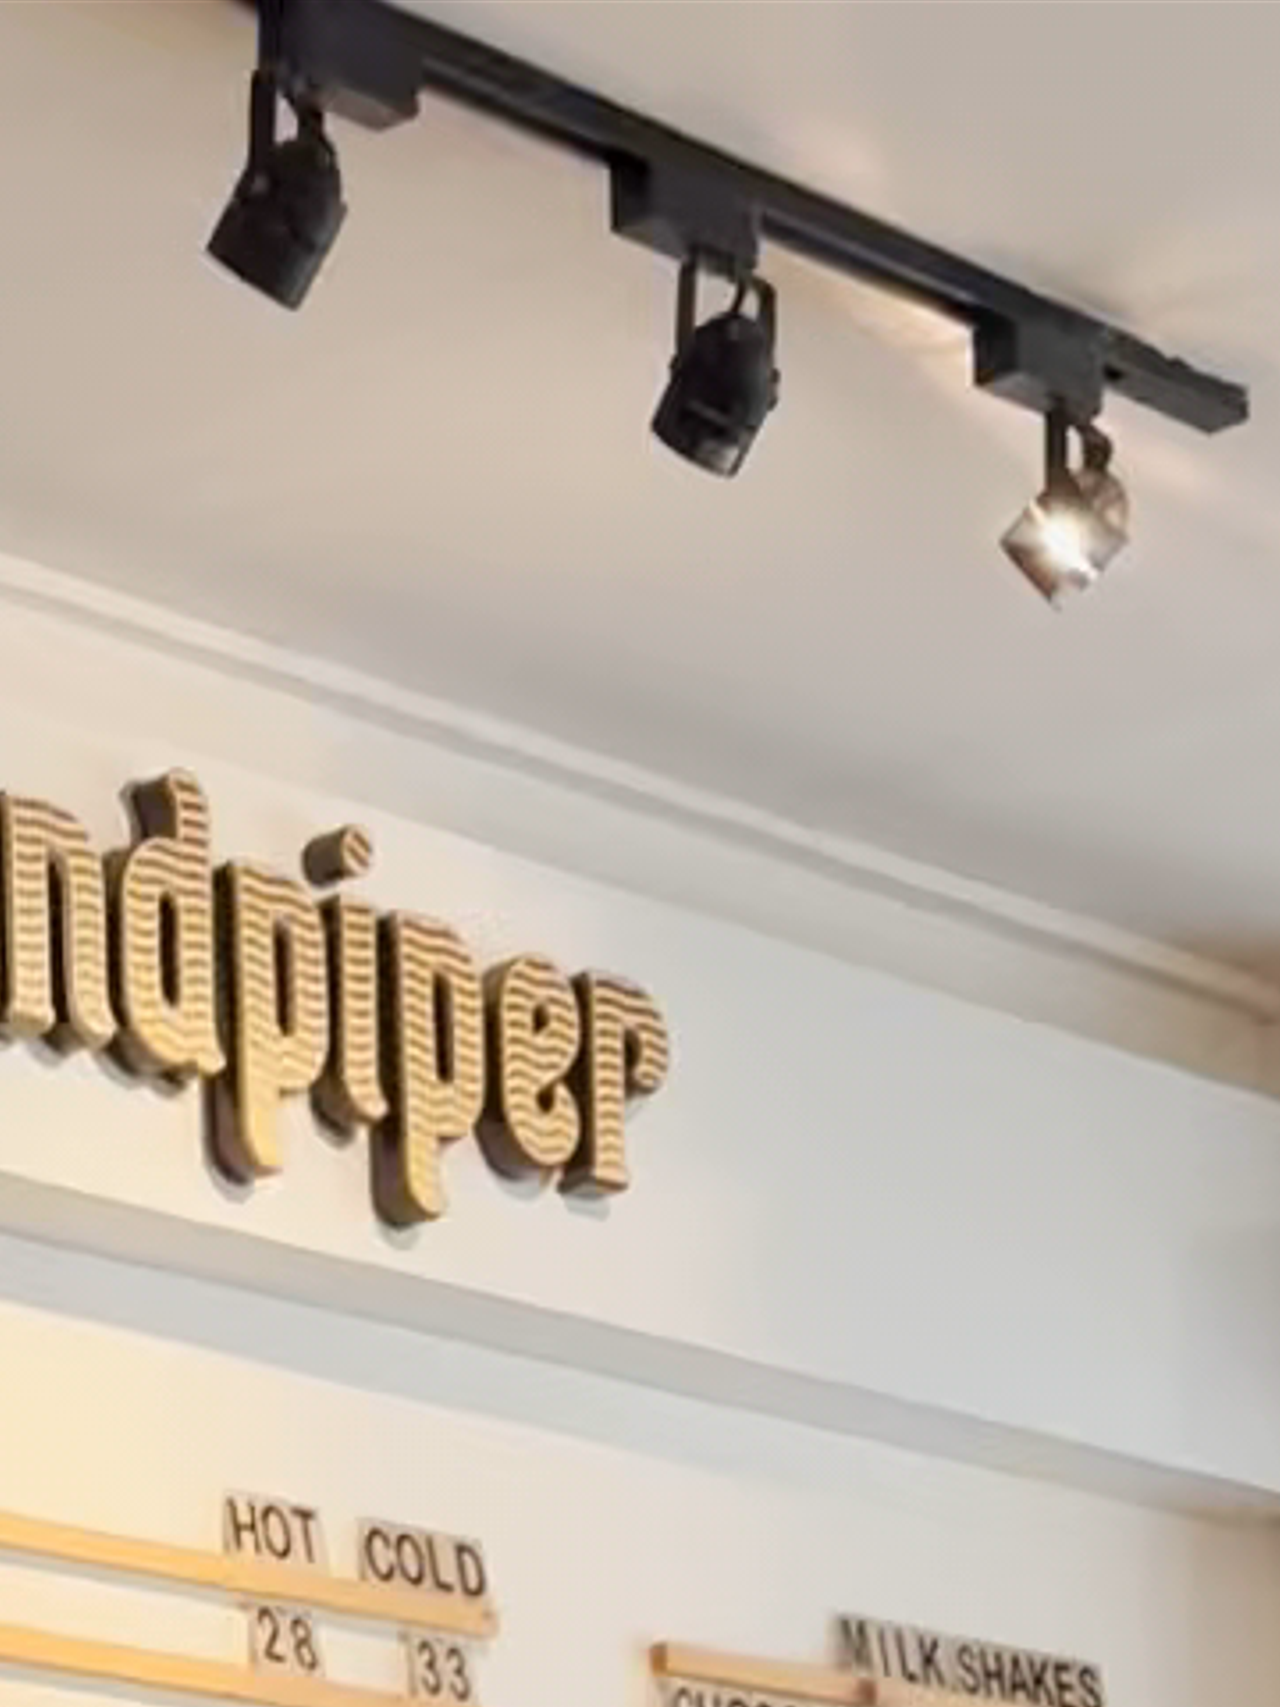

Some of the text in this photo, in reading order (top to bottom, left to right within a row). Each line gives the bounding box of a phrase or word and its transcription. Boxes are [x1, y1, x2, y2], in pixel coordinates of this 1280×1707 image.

[225, 1496, 488, 1598] HOT COLD
[264, 1608, 318, 1673] 28
[419, 1638, 472, 1703] 33
